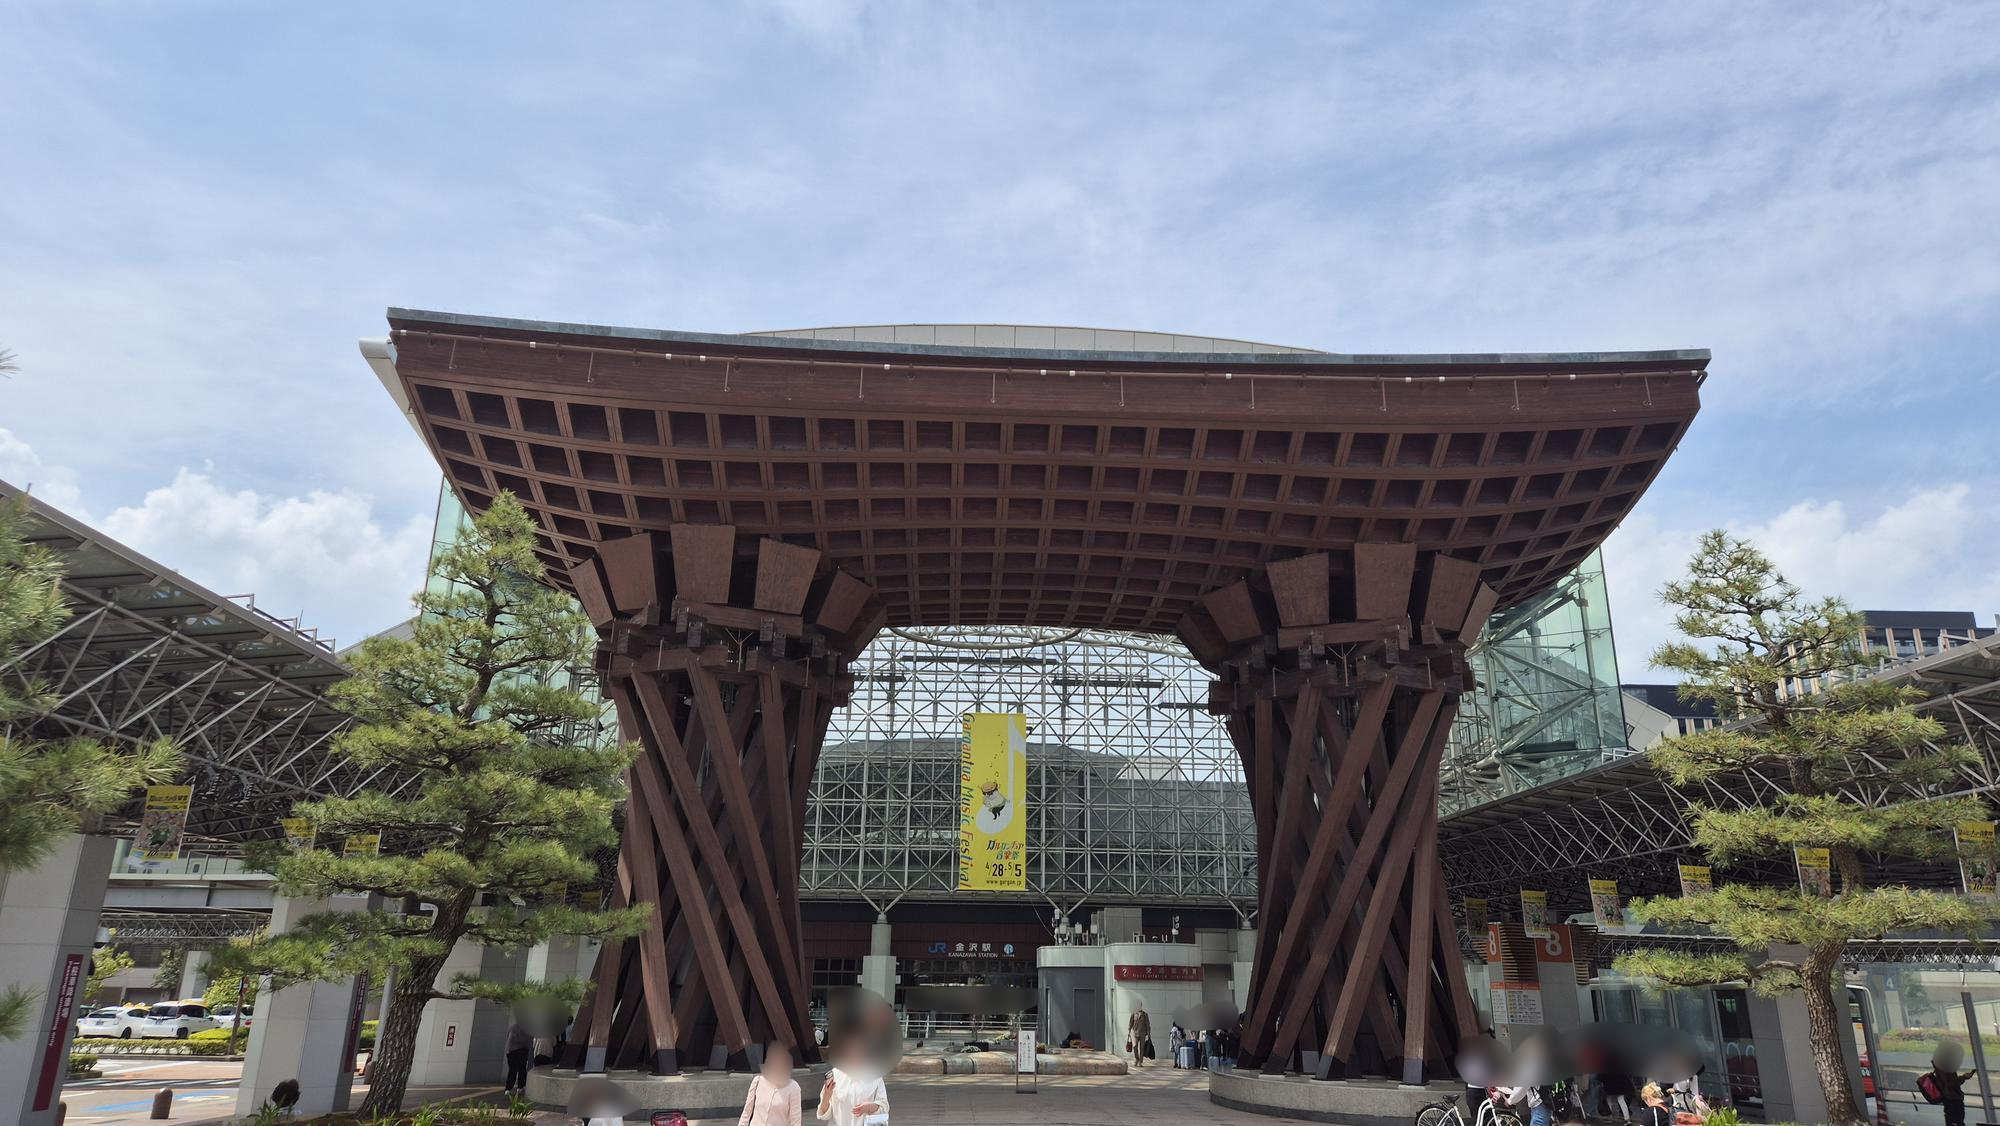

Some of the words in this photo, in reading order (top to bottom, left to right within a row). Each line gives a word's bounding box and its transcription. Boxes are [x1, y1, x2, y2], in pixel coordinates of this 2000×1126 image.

[962, 712, 975, 782] Gargantua
[961, 786, 974, 825] Music
[959, 830, 974, 888] Festival
[928, 943, 946, 954] JR
[955, 942, 992, 952] 金沢駅
[1545, 931, 1562, 956] 8
